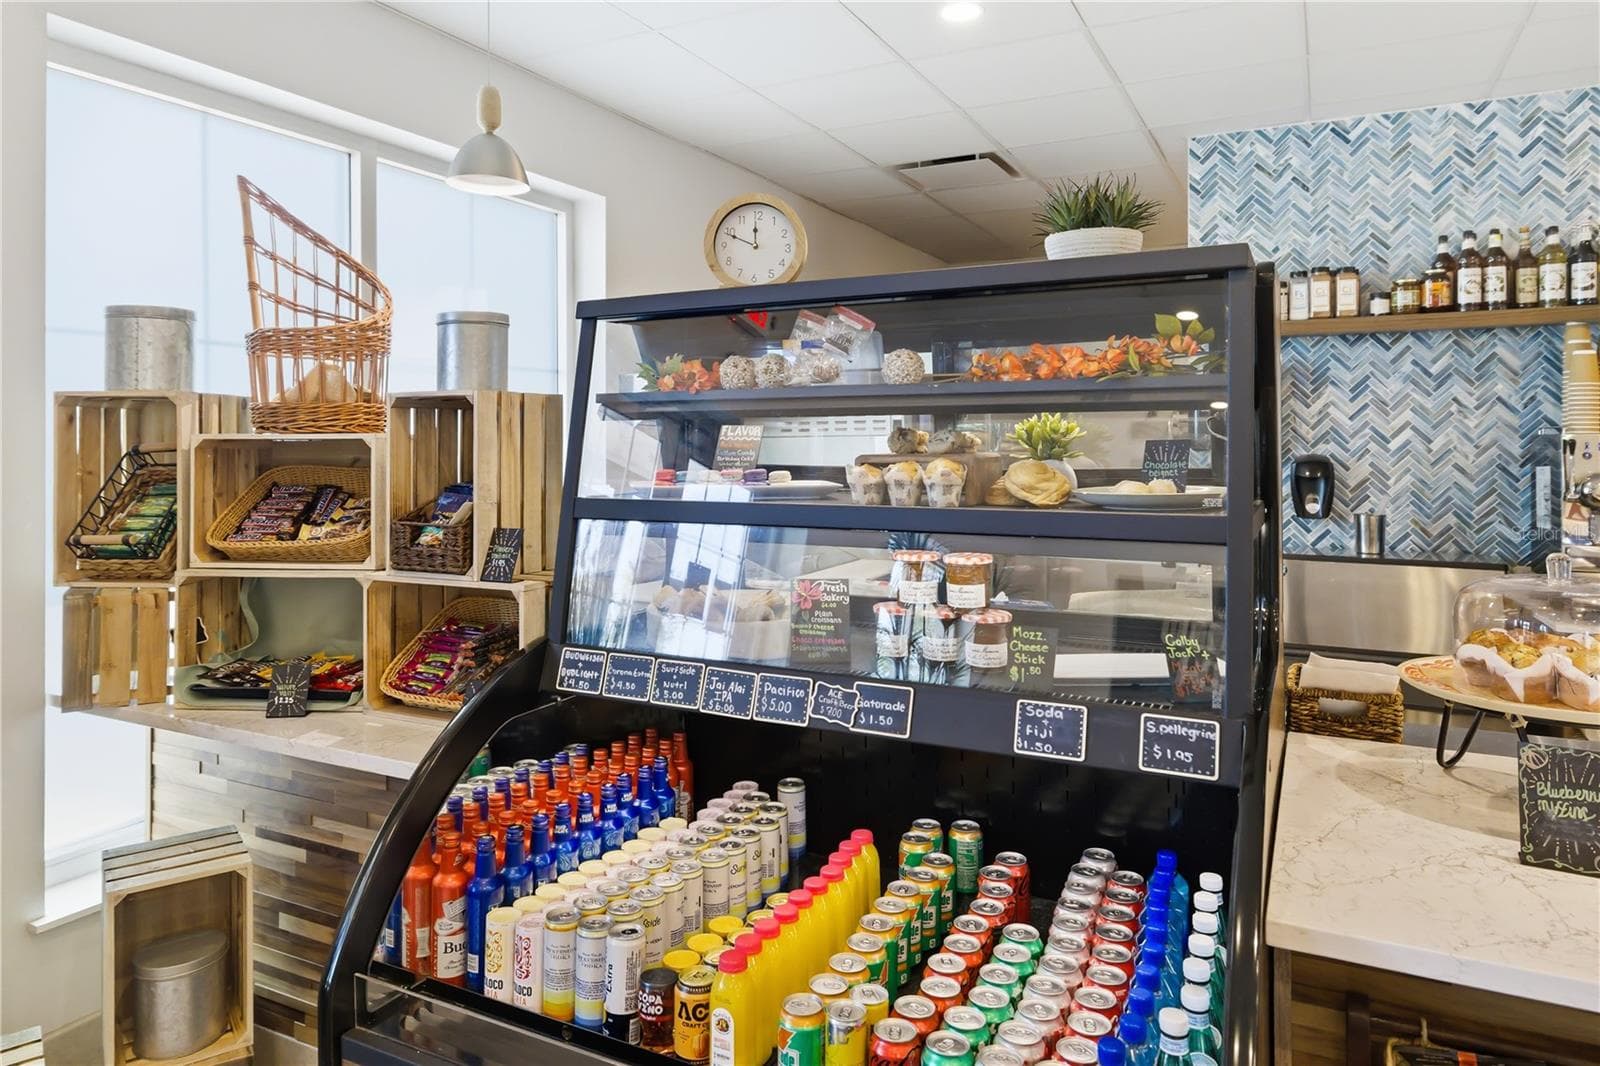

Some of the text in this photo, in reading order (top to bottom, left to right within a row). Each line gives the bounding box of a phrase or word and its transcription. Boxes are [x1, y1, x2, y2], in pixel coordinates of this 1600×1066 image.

[738, 215, 746, 225] 11
[753, 210, 763, 221] 12
[772, 216, 776, 226] 1
[781, 229, 788, 239] 2
[721, 241, 727, 249] 9
[784, 244, 792, 254] 3
[725, 257, 732, 266] 8
[778, 258, 785, 267] 4
[737, 268, 743, 277] 7
[768, 269, 775, 278] 5
[751, 274, 757, 283] 6
[1009, 640, 1049, 653] Cheese
[1165, 633, 1200, 653] Colby
[1014, 652, 1046, 665] Stick
[709, 677, 725, 690] Jai
[764, 682, 805, 698] Pacifico
[828, 689, 844, 699] ACE
[713, 691, 732, 703] IPA
[1025, 705, 1063, 720] Soda
[678, 1001, 709, 1022] AC
